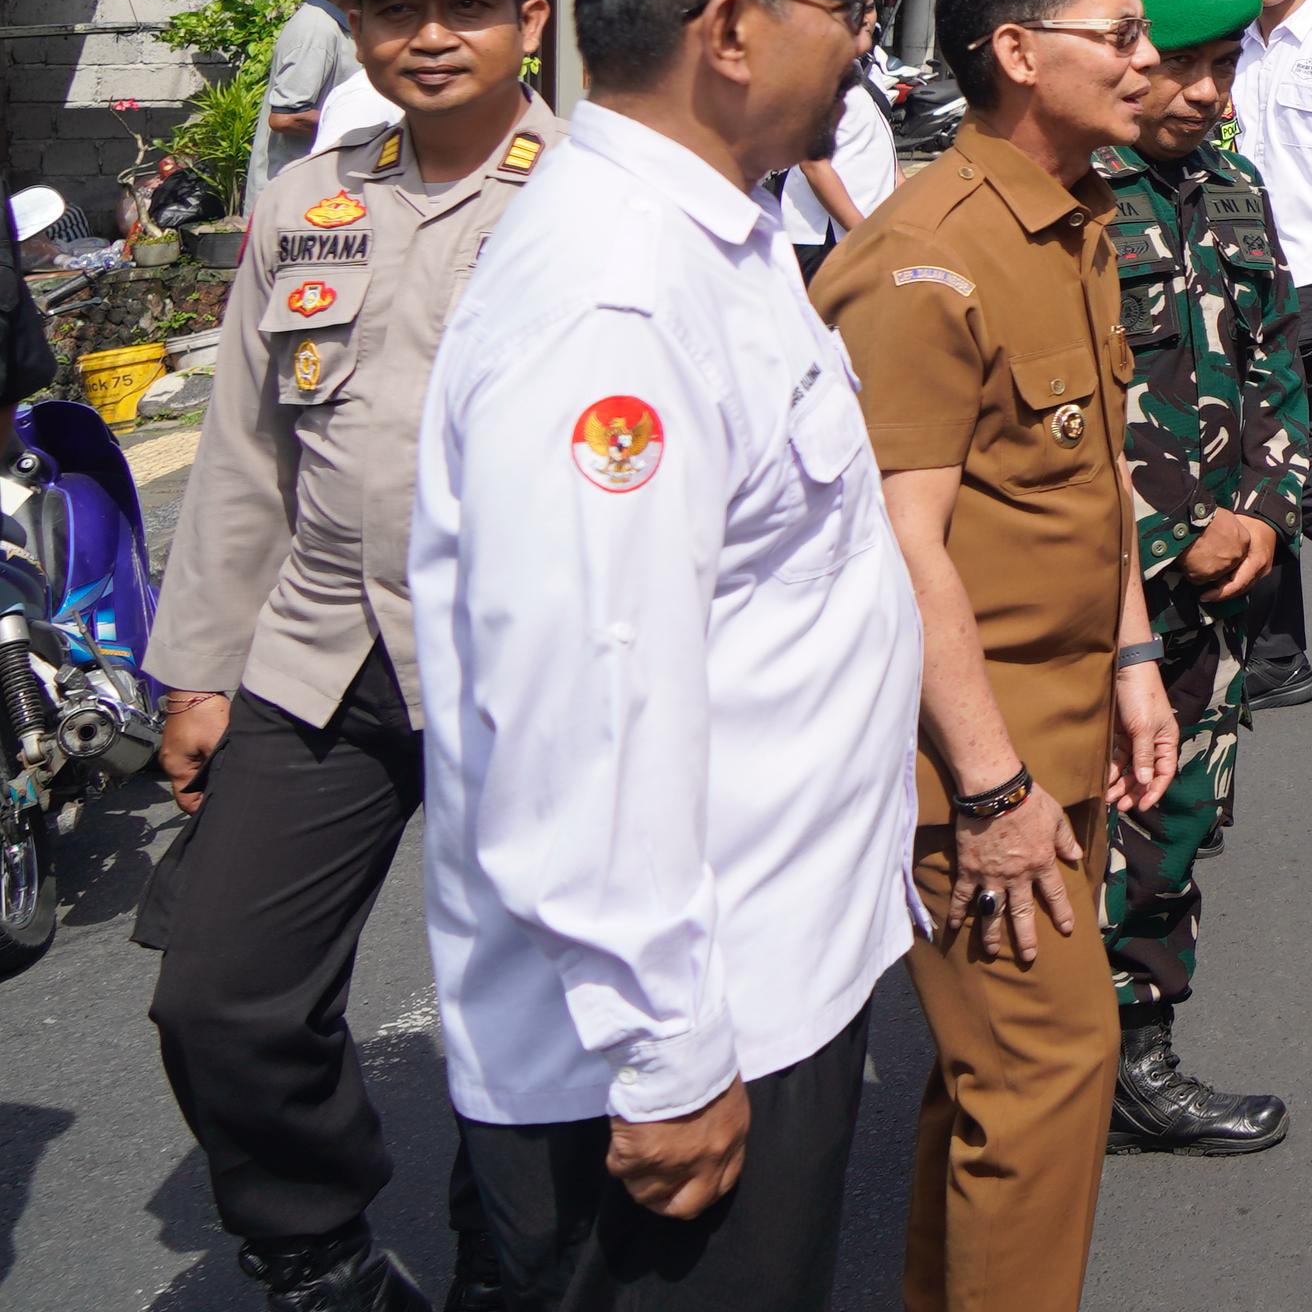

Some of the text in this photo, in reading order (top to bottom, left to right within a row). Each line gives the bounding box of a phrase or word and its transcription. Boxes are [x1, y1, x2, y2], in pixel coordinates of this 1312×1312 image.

[1212, 198, 1240, 214] TNI
[279, 233, 368, 264] SURYANA
[112, 374, 133, 388] 75
